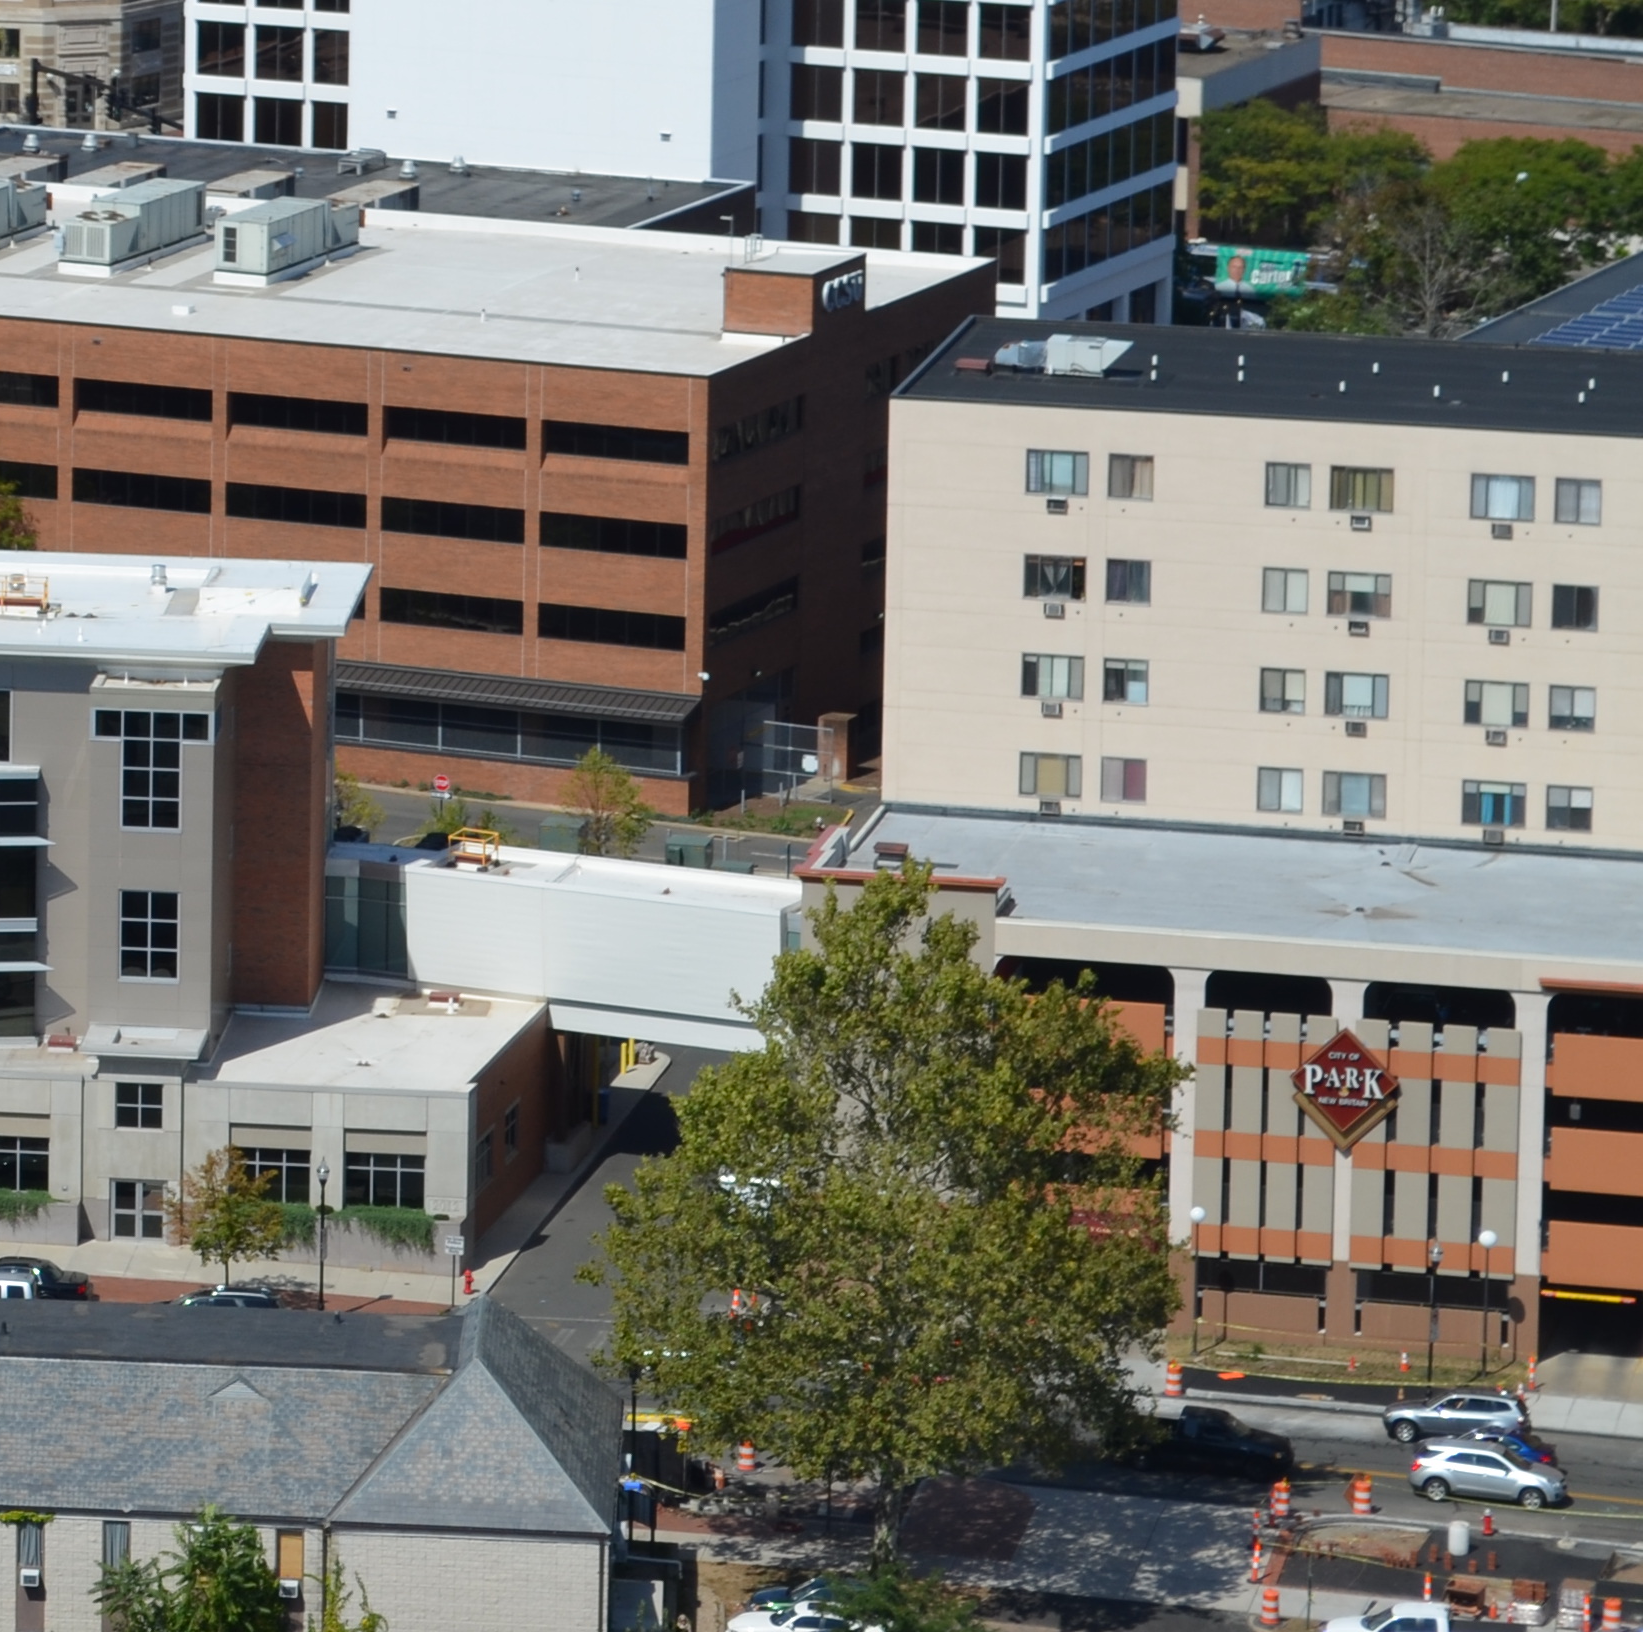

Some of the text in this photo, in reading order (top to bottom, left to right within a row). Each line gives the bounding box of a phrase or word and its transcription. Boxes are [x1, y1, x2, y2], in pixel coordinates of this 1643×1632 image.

[822, 270, 863, 312] CCSU
[1328, 1051, 1360, 1061] CITY OF
[1318, 1096, 1369, 1107] NEW BRITAIN
